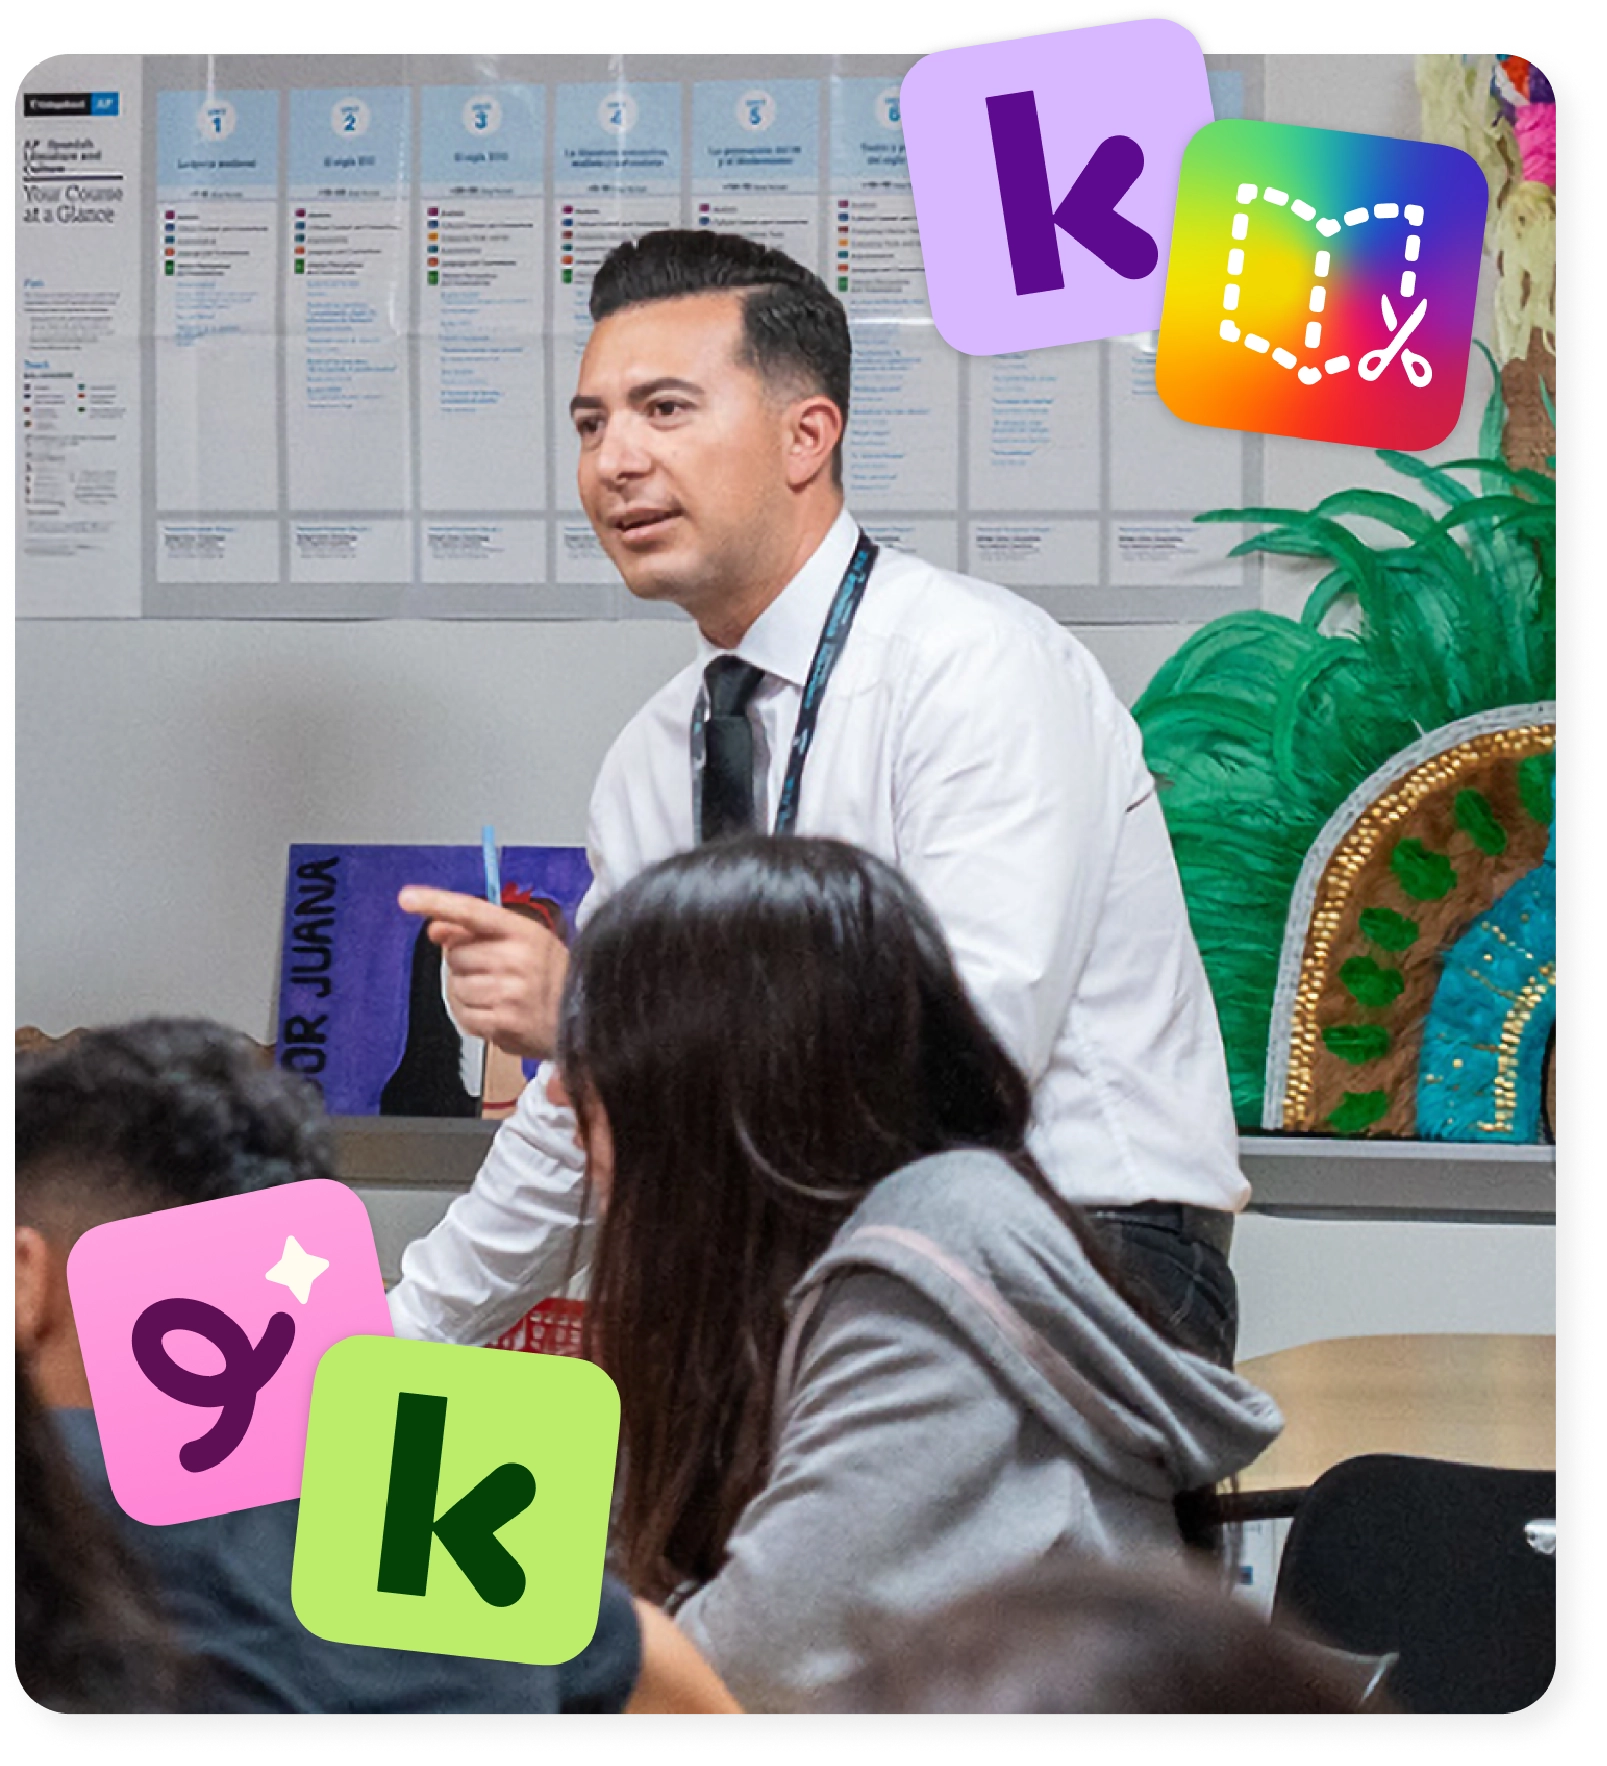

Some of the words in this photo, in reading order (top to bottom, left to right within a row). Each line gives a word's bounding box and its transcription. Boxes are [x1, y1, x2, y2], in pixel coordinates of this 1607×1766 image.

[212, 117, 221, 133] 1
[344, 114, 356, 131] 2
[475, 112, 488, 129] 3
[24, 184, 62, 202] Your
[65, 184, 124, 202] Course
[24, 206, 41, 223] at
[43, 208, 54, 223] a
[57, 204, 116, 223] Glance
[289, 856, 340, 998] JUANA
